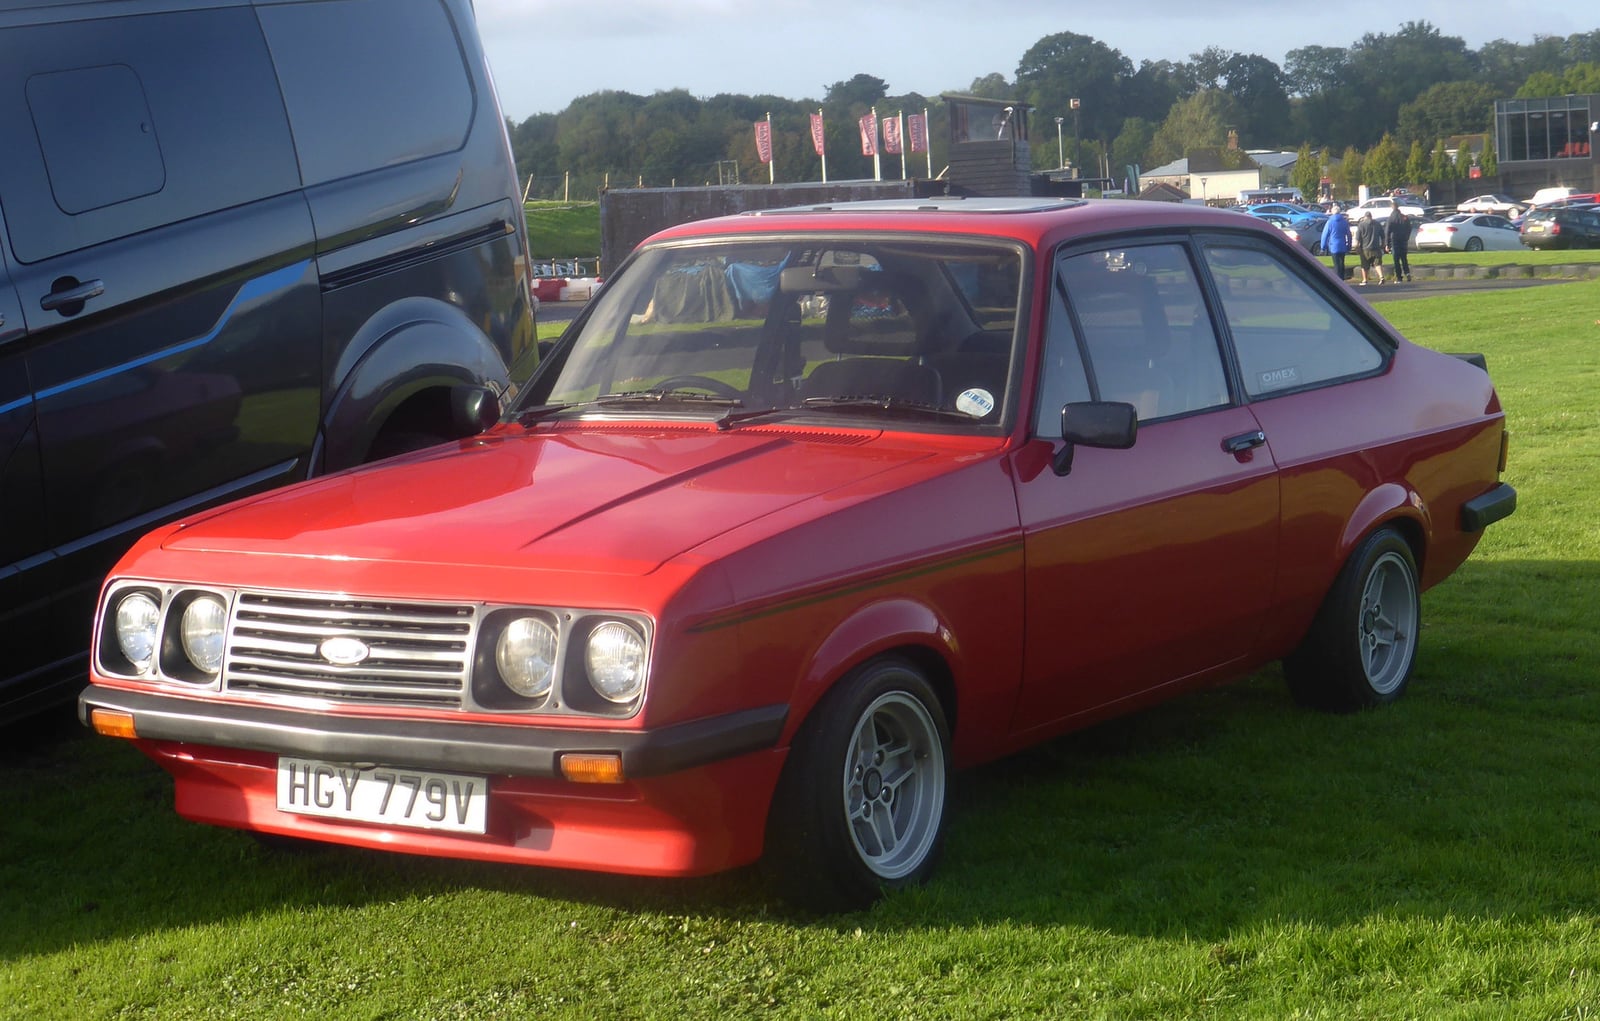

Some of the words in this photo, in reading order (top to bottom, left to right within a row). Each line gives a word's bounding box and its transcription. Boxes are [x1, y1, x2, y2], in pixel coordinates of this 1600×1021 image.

[1262, 367, 1296, 382] OMEX
[289, 762, 361, 811] HGY
[374, 772, 474, 825] 779V
